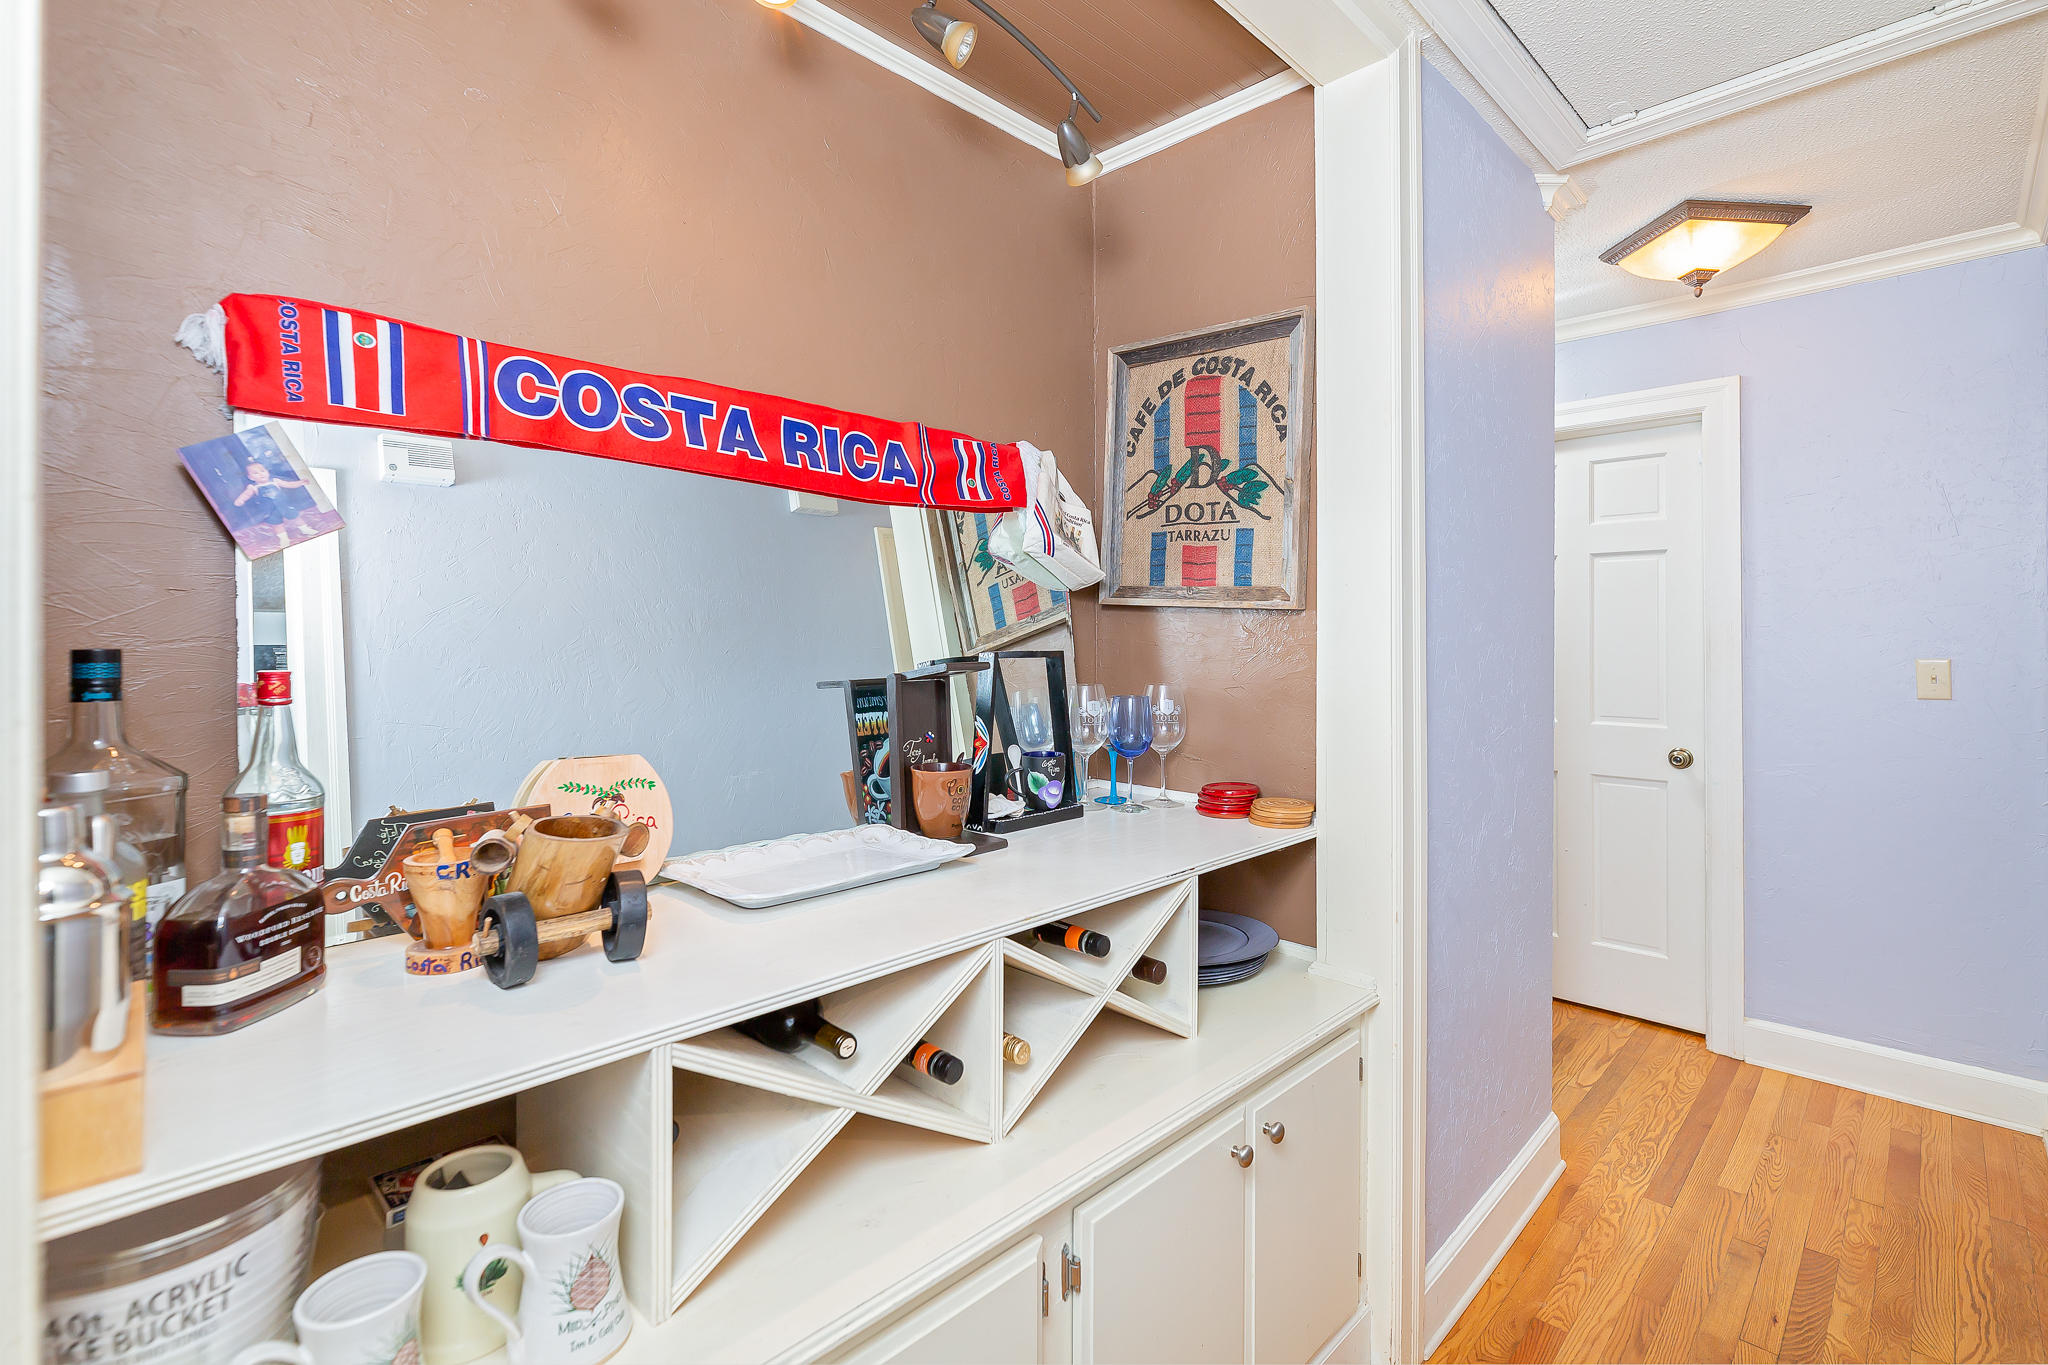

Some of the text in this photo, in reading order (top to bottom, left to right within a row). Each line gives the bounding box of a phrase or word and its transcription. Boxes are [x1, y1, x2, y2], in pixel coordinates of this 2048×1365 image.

[282, 359, 304, 403] RICA
[1126, 355, 1289, 457] CAFE DE COSTA RICA
[493, 355, 919, 488] COSTA RICA
[990, 442, 1012, 501] COSTA RICA
[1184, 445, 1221, 489] D
[1165, 500, 1237, 523] DOTA
[1167, 528, 1232, 543] TARRAZU
[349, 871, 409, 903] Costa Ri
[125, 1252, 250, 1325] ACRYLIC
[112, 1286, 232, 1354] BUCKET
